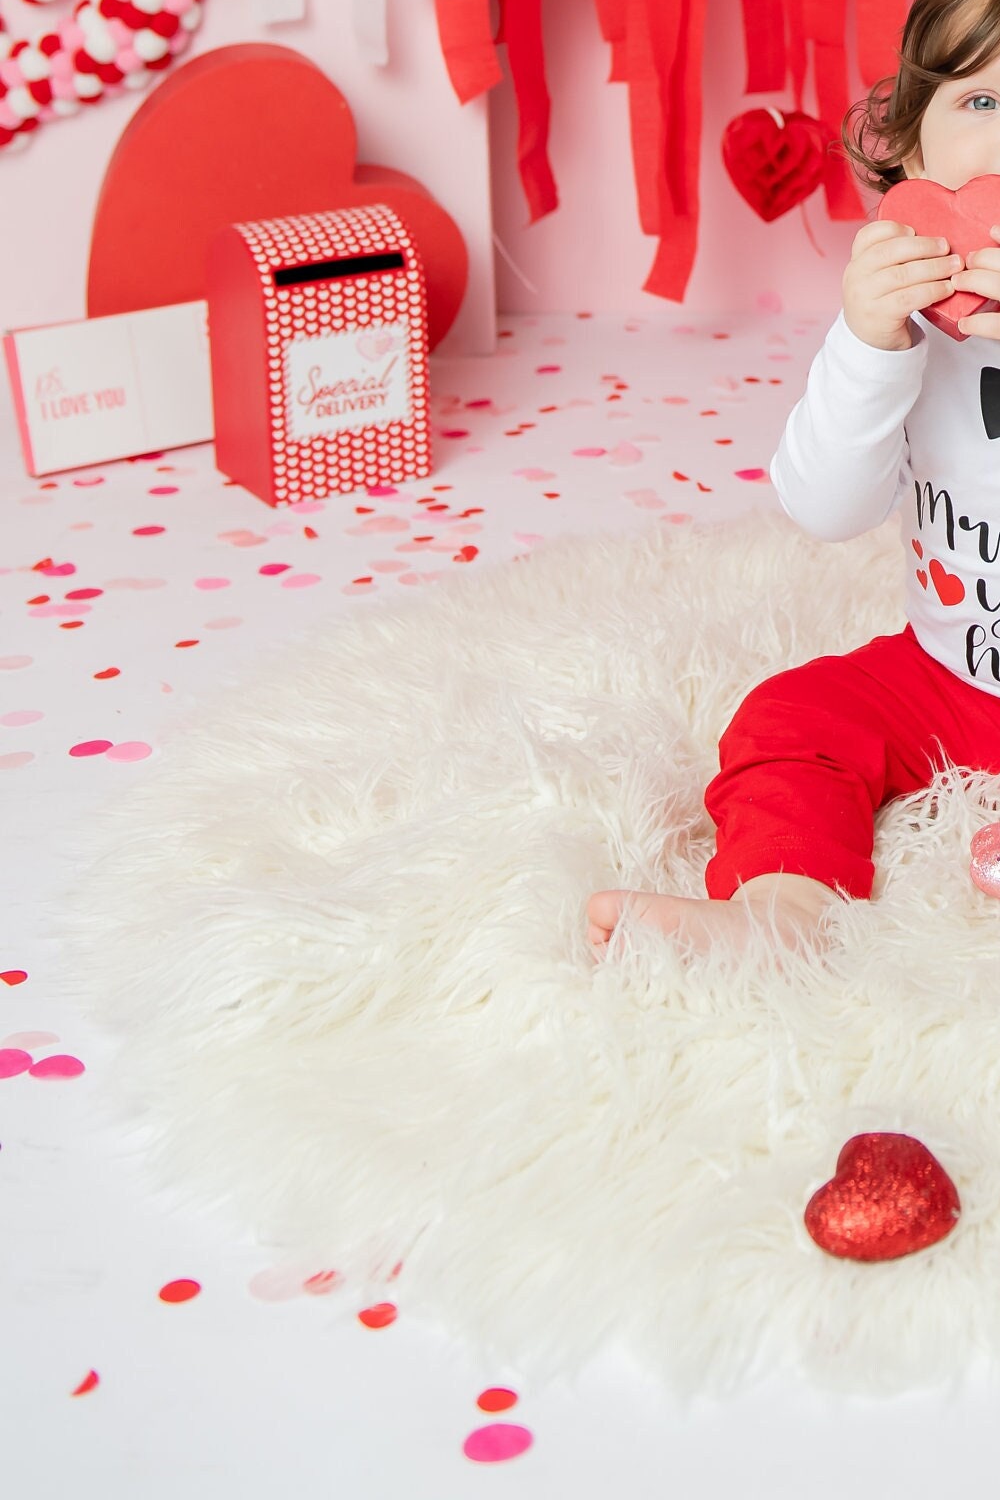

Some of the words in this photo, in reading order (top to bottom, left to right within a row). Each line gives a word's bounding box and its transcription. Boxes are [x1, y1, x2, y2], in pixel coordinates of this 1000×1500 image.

[50, 391, 92, 421] LOVE
[93, 385, 128, 411] YOU
[296, 354, 400, 416] Special
[315, 391, 389, 418] DELIVERY
